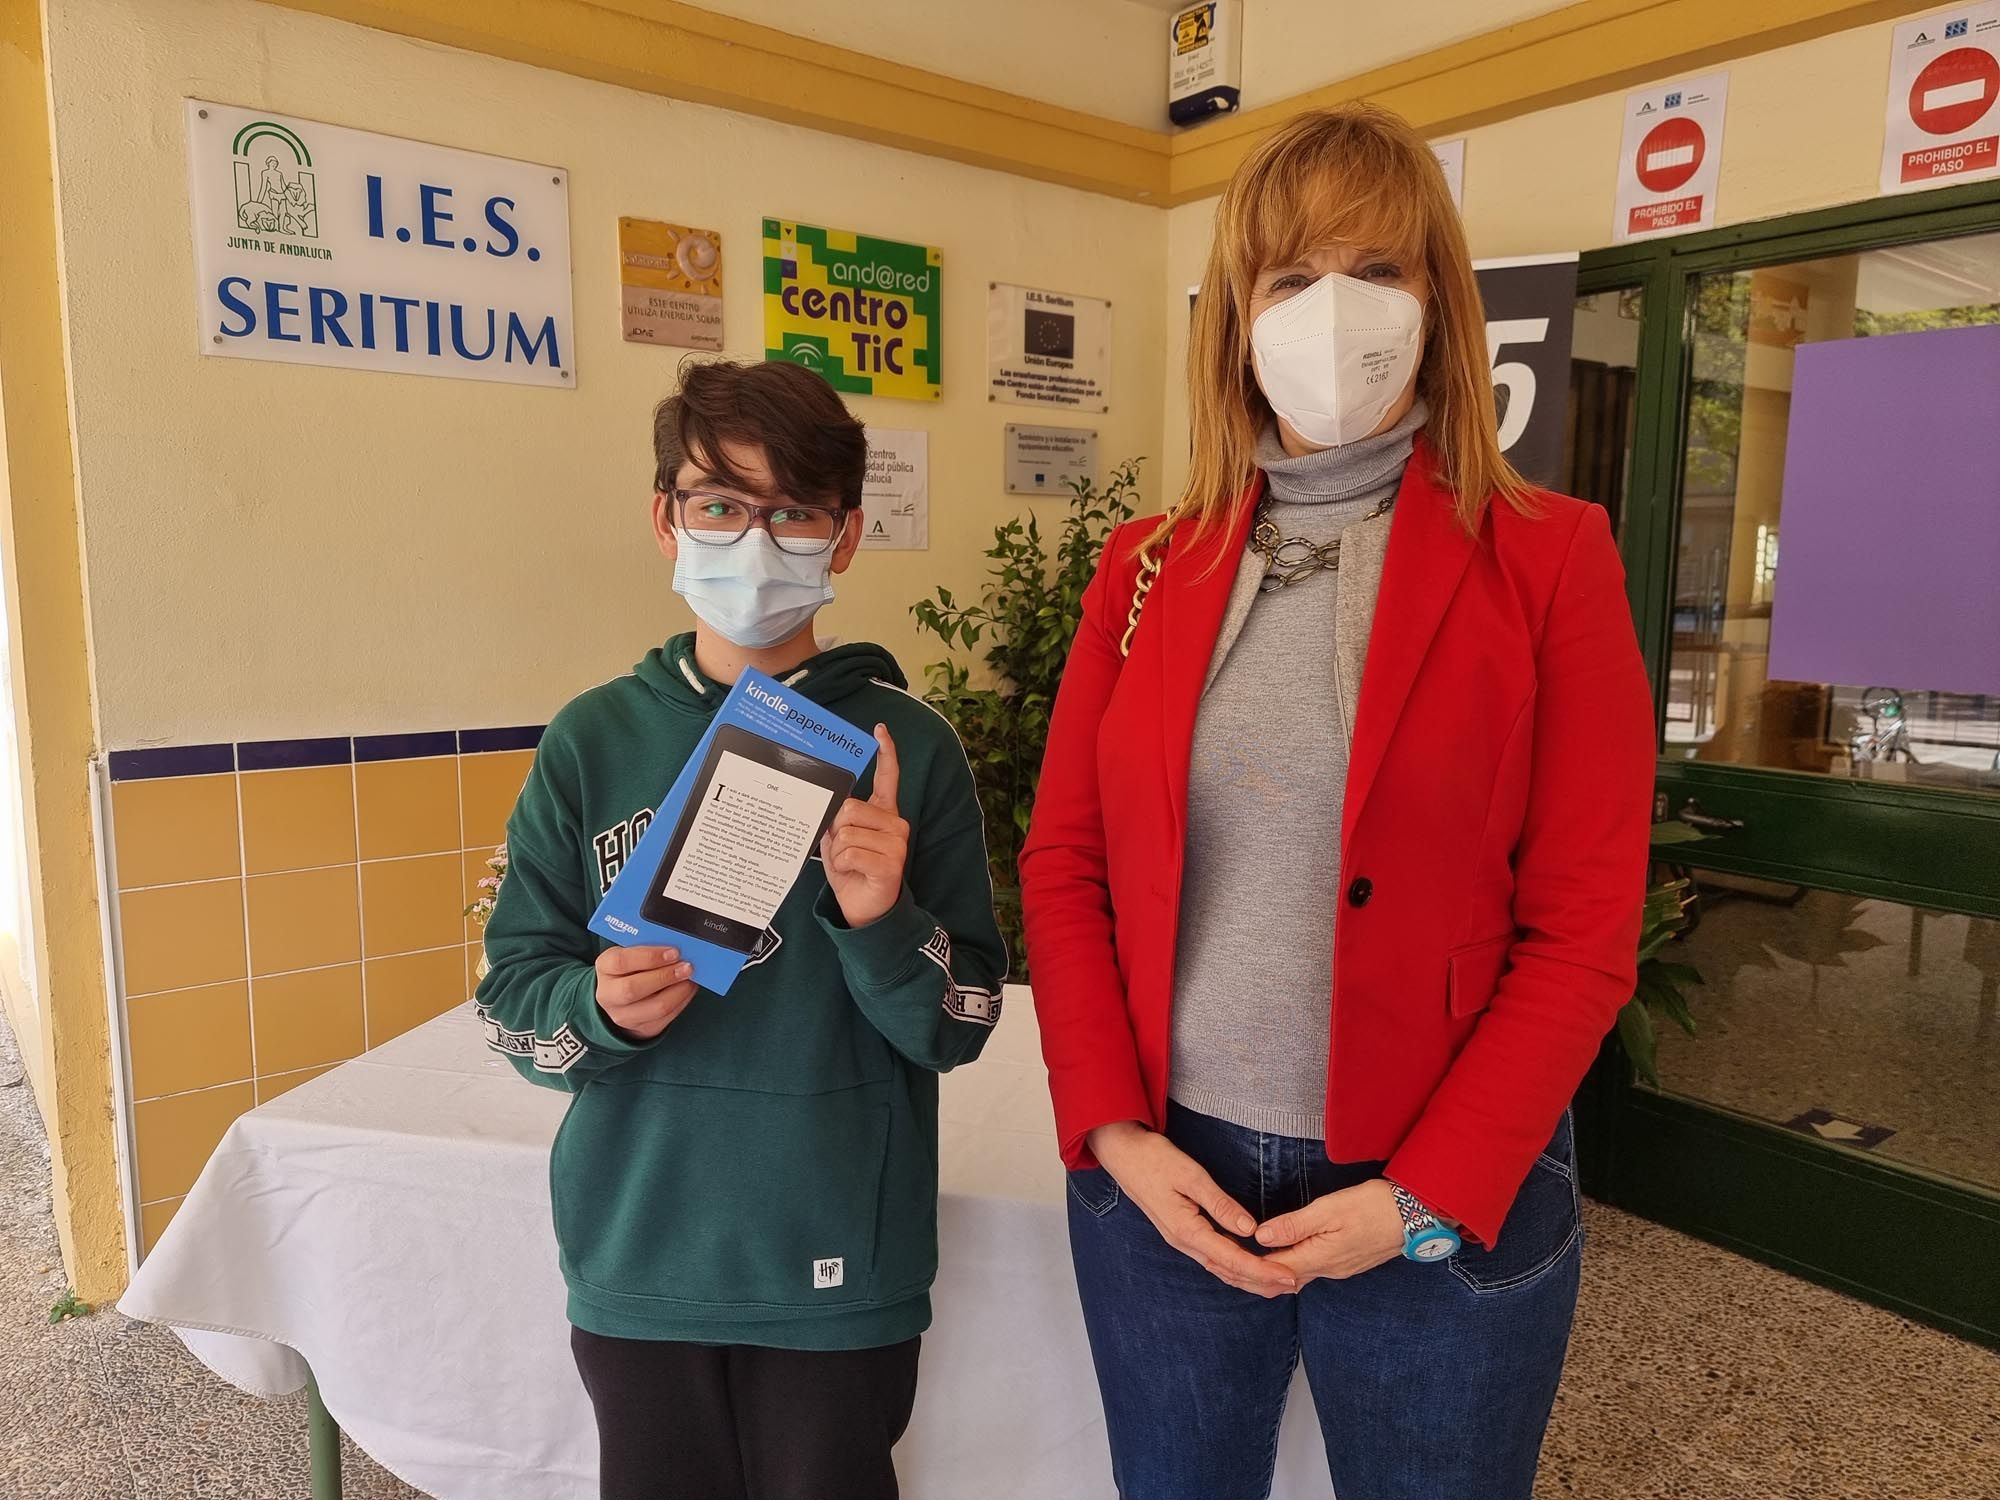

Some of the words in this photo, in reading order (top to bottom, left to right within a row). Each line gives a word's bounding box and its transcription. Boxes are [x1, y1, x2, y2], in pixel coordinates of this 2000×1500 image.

[1908, 144, 1973, 167] PROHIBIDO
[1975, 141, 1991, 154] EL
[1932, 161, 1964, 175] PASO
[1634, 200, 1683, 219] PROHIBIDO
[1685, 199, 1697, 210] EL
[366, 174, 540, 262] I.E.S.
[1652, 215, 1677, 228] PASO
[227, 236, 261, 251] JUNTA
[263, 241, 277, 254] DE
[833, 261, 930, 293] and@red
[648, 298, 666, 309] ESTE
[669, 300, 699, 313] CENTRO
[782, 286, 908, 330] centro
[1026, 292, 1044, 304] I.E.S.
[1045, 294, 1074, 308] Seritium
[217, 276, 561, 369] SERITIUM
[627, 305, 657, 317] UTILIZA
[696, 315, 721, 324] SOLAR
[1024, 355, 1045, 367] Unión
[1046, 358, 1074, 370] Europea
[1007, 379, 1028, 389] Centro
[1016, 390, 1036, 400] Fondo
[1037, 392, 1055, 402] Social
[1056, 394, 1080, 405] Europeo
[869, 448, 897, 460] centros
[887, 461, 914, 474] pública
[745, 680, 789, 716] kindle
[785, 707, 865, 759] paperwhite
[766, 783, 780, 792] ONE
[604, 913, 639, 936] amazon
[703, 917, 729, 934] kindle
